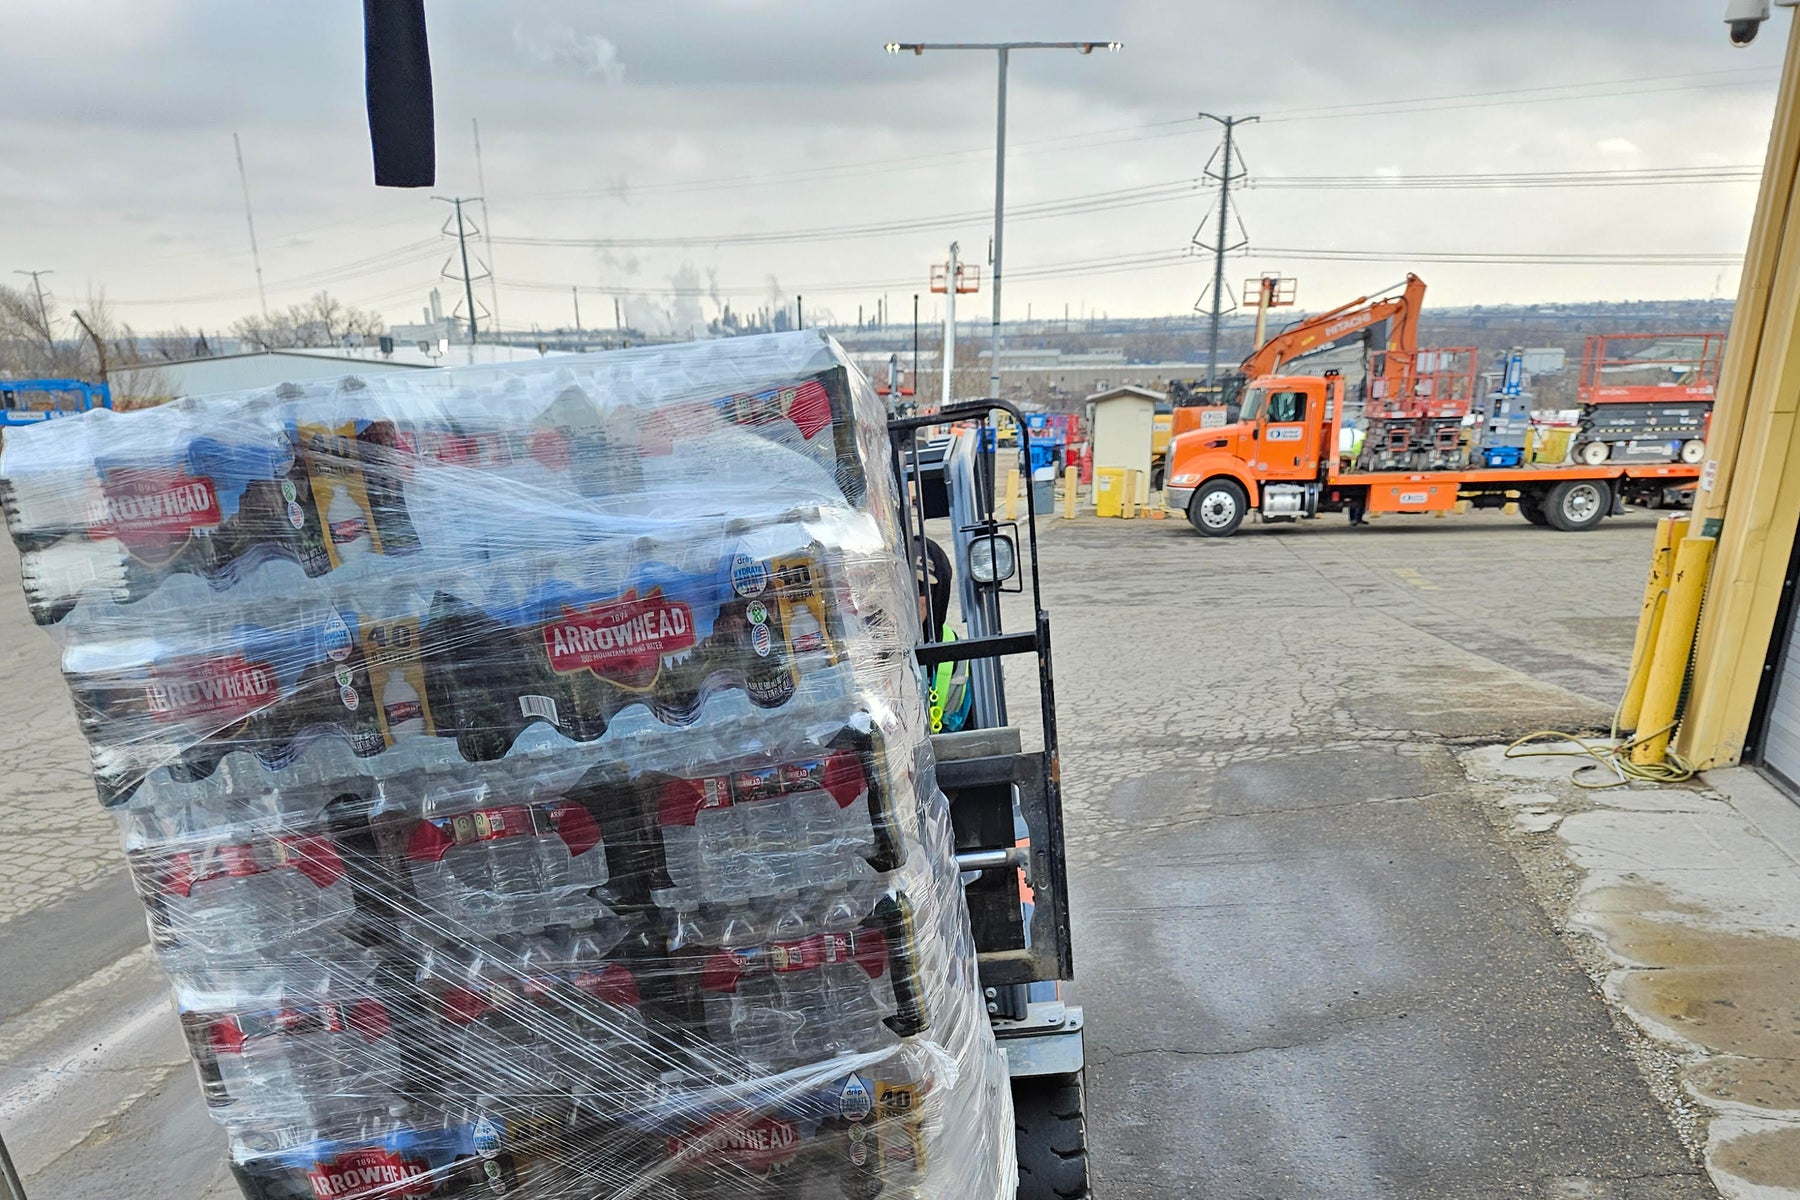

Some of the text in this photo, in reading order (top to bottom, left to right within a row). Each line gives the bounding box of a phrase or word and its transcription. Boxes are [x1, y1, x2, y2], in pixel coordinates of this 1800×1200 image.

[611, 612, 629, 624] 1894
[554, 607, 687, 657] ARROWHEAD
[879, 1089, 912, 1109] 40
[356, 1158, 377, 1166] 1894
[311, 1165, 422, 1196] ARROWHEAD
